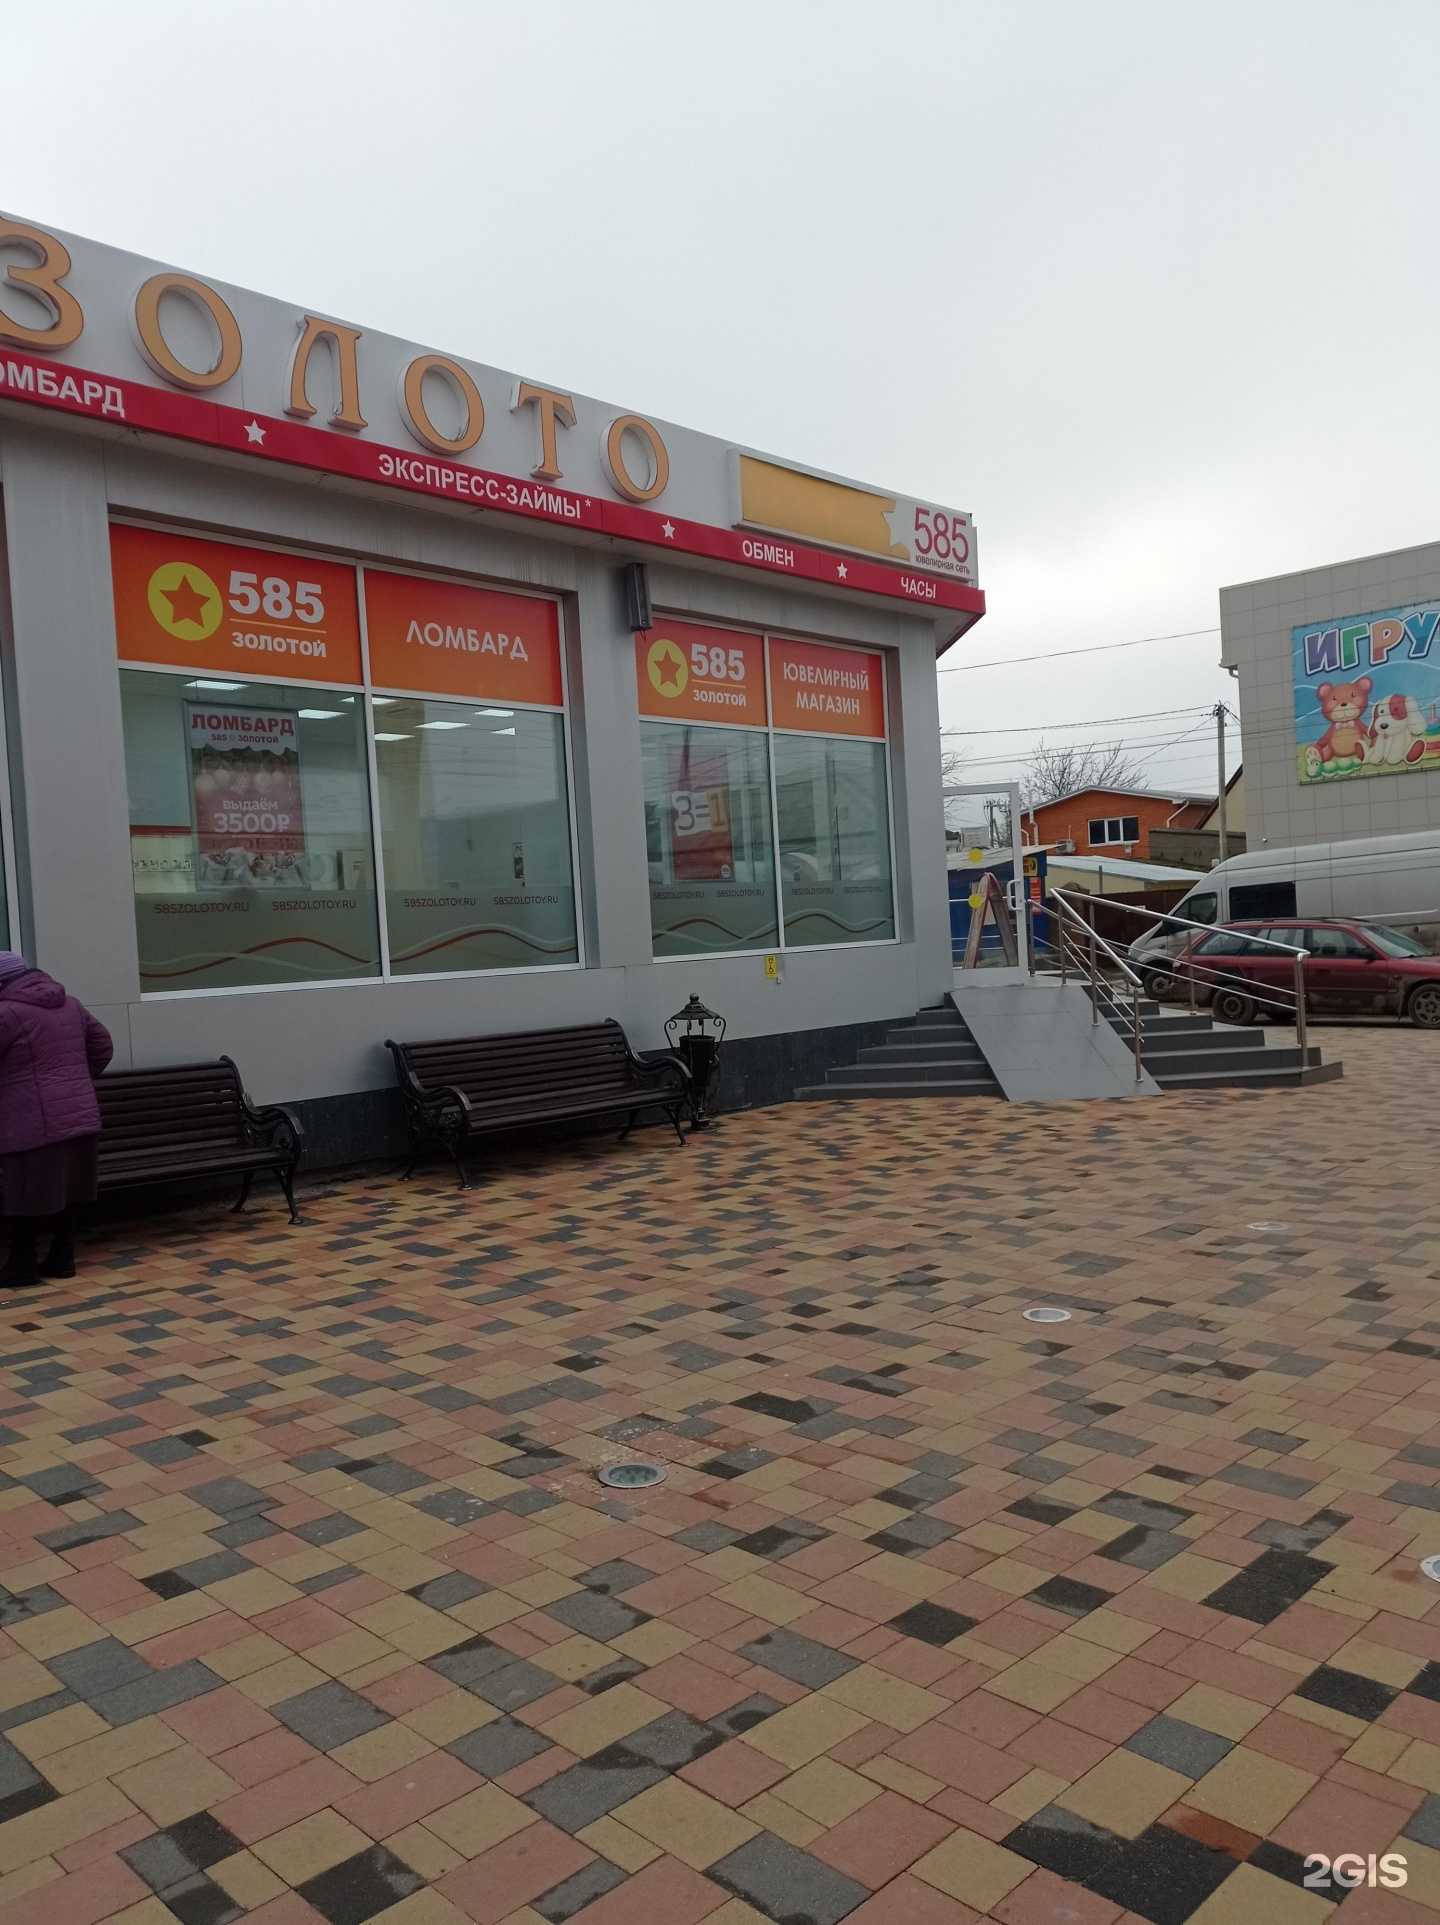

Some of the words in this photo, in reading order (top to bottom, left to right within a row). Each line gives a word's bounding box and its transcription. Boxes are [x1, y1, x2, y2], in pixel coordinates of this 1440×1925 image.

[0, 214, 671, 501] ЗОЛОТО
[0, 361, 125, 418] МБАРД
[742, 539, 794, 568] ОБМЕН
[914, 506, 969, 563] 585
[915, 554, 954, 571] ювелирная
[228, 569, 325, 624] 585
[900, 576, 937, 599] ЧАСЫ
[406, 620, 529, 662] ЛОМБАРД
[1304, 611, 1440, 677] ИГРУ
[691, 642, 745, 682] 585
[783, 661, 870, 692] ЮВЕЛИРНЫЙ
[796, 690, 860, 716] МАГАЗИН
[191, 713, 295, 737] ЛОМБАРД
